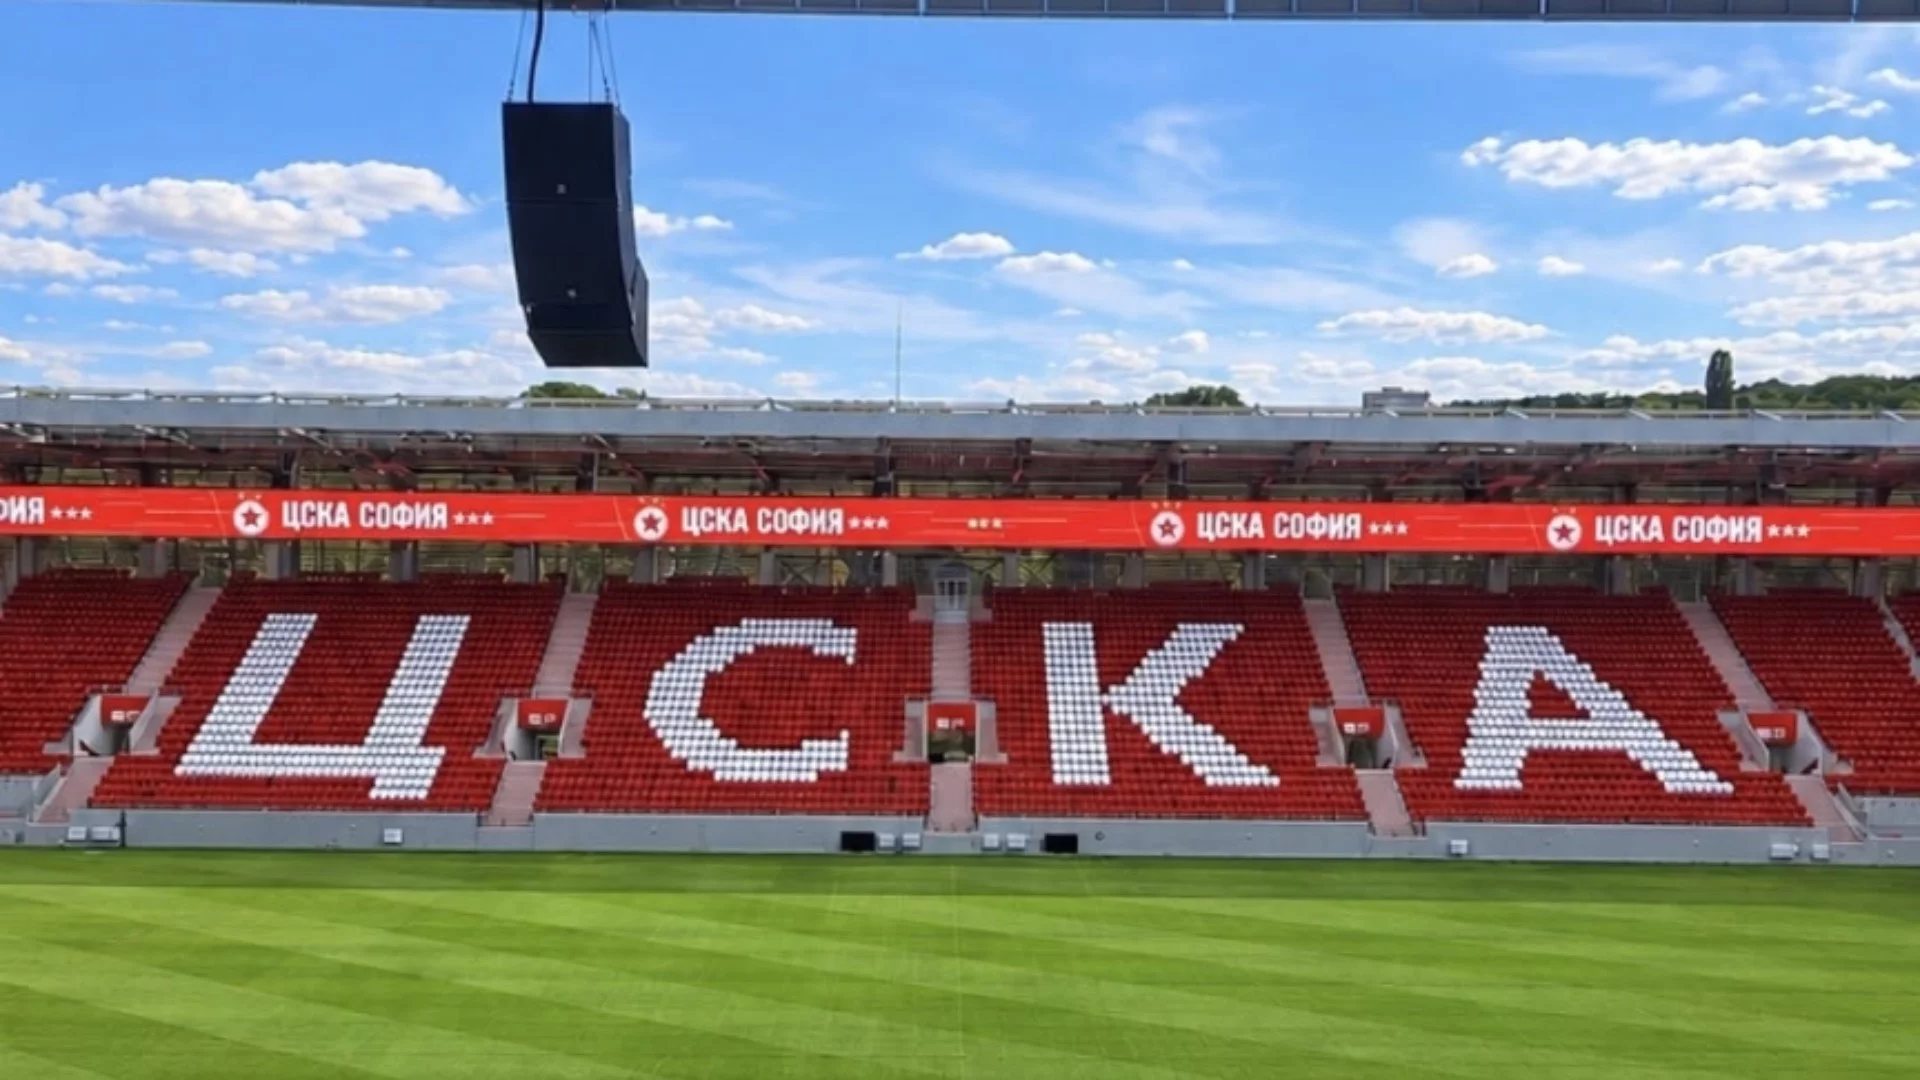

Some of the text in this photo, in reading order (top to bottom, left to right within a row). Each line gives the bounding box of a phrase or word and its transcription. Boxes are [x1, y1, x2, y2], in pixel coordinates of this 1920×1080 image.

[282, 500, 448, 530] ЦСКА СОФИЯ
[681, 507, 844, 537] ЦСКА СОФИЯ
[1197, 511, 1362, 541] ЦСКА СОФИЯ
[1595, 515, 1763, 545] ЦСКА СОФИЯ
[175, 614, 1733, 800] ЦСКА
